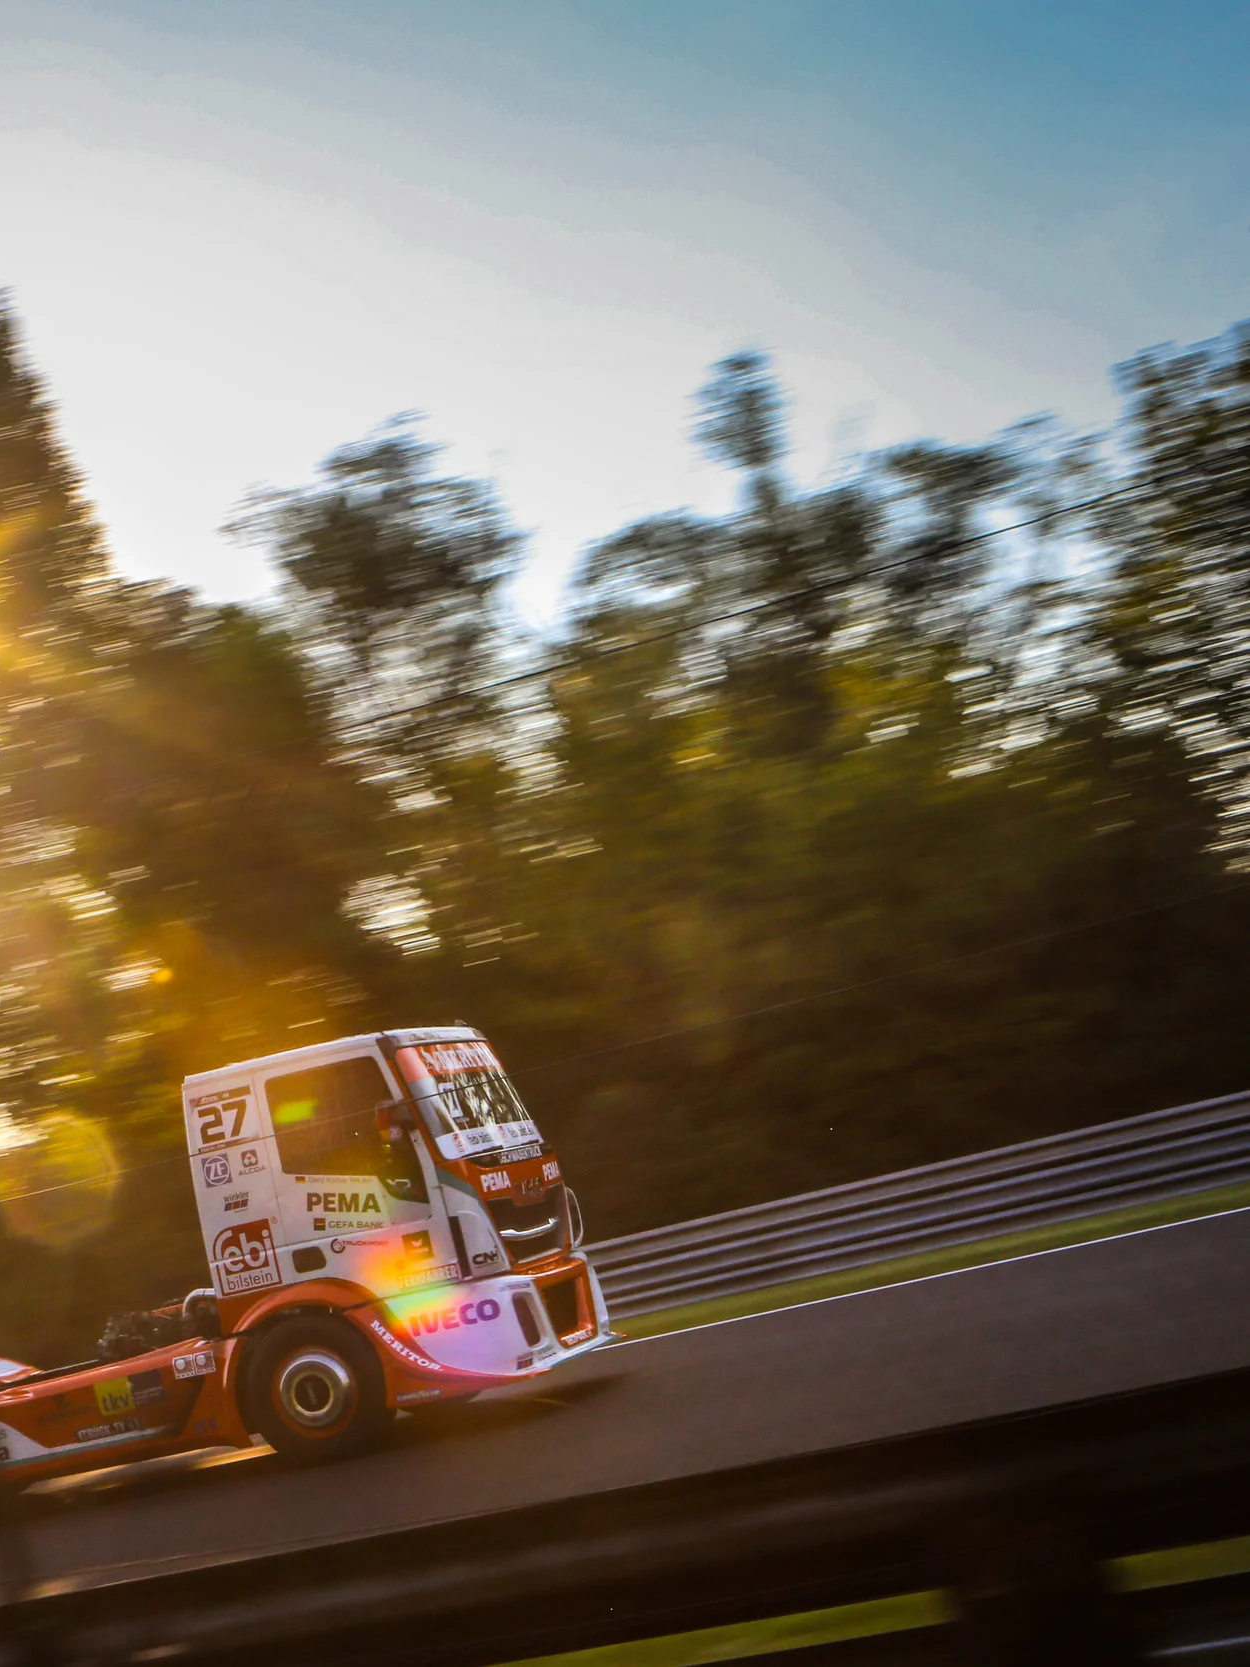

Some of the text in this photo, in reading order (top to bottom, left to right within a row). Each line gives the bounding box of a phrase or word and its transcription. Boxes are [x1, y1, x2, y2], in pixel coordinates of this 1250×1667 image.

[197, 1099, 247, 1145] 27
[205, 1160, 228, 1181] ZF
[238, 1164, 266, 1176] ALCOA
[542, 1161, 561, 1182] PEMA
[480, 1170, 512, 1193] PEMA
[223, 1190, 250, 1203] winkler
[307, 1191, 382, 1213] PEMA
[328, 1220, 384, 1229] GEFA BANK
[213, 1228, 272, 1284] febi
[227, 1270, 273, 1291] bilstein
[410, 1298, 501, 1337] IVECO
[370, 1319, 442, 1371] MERITOR
[102, 1392, 131, 1413] tkv
